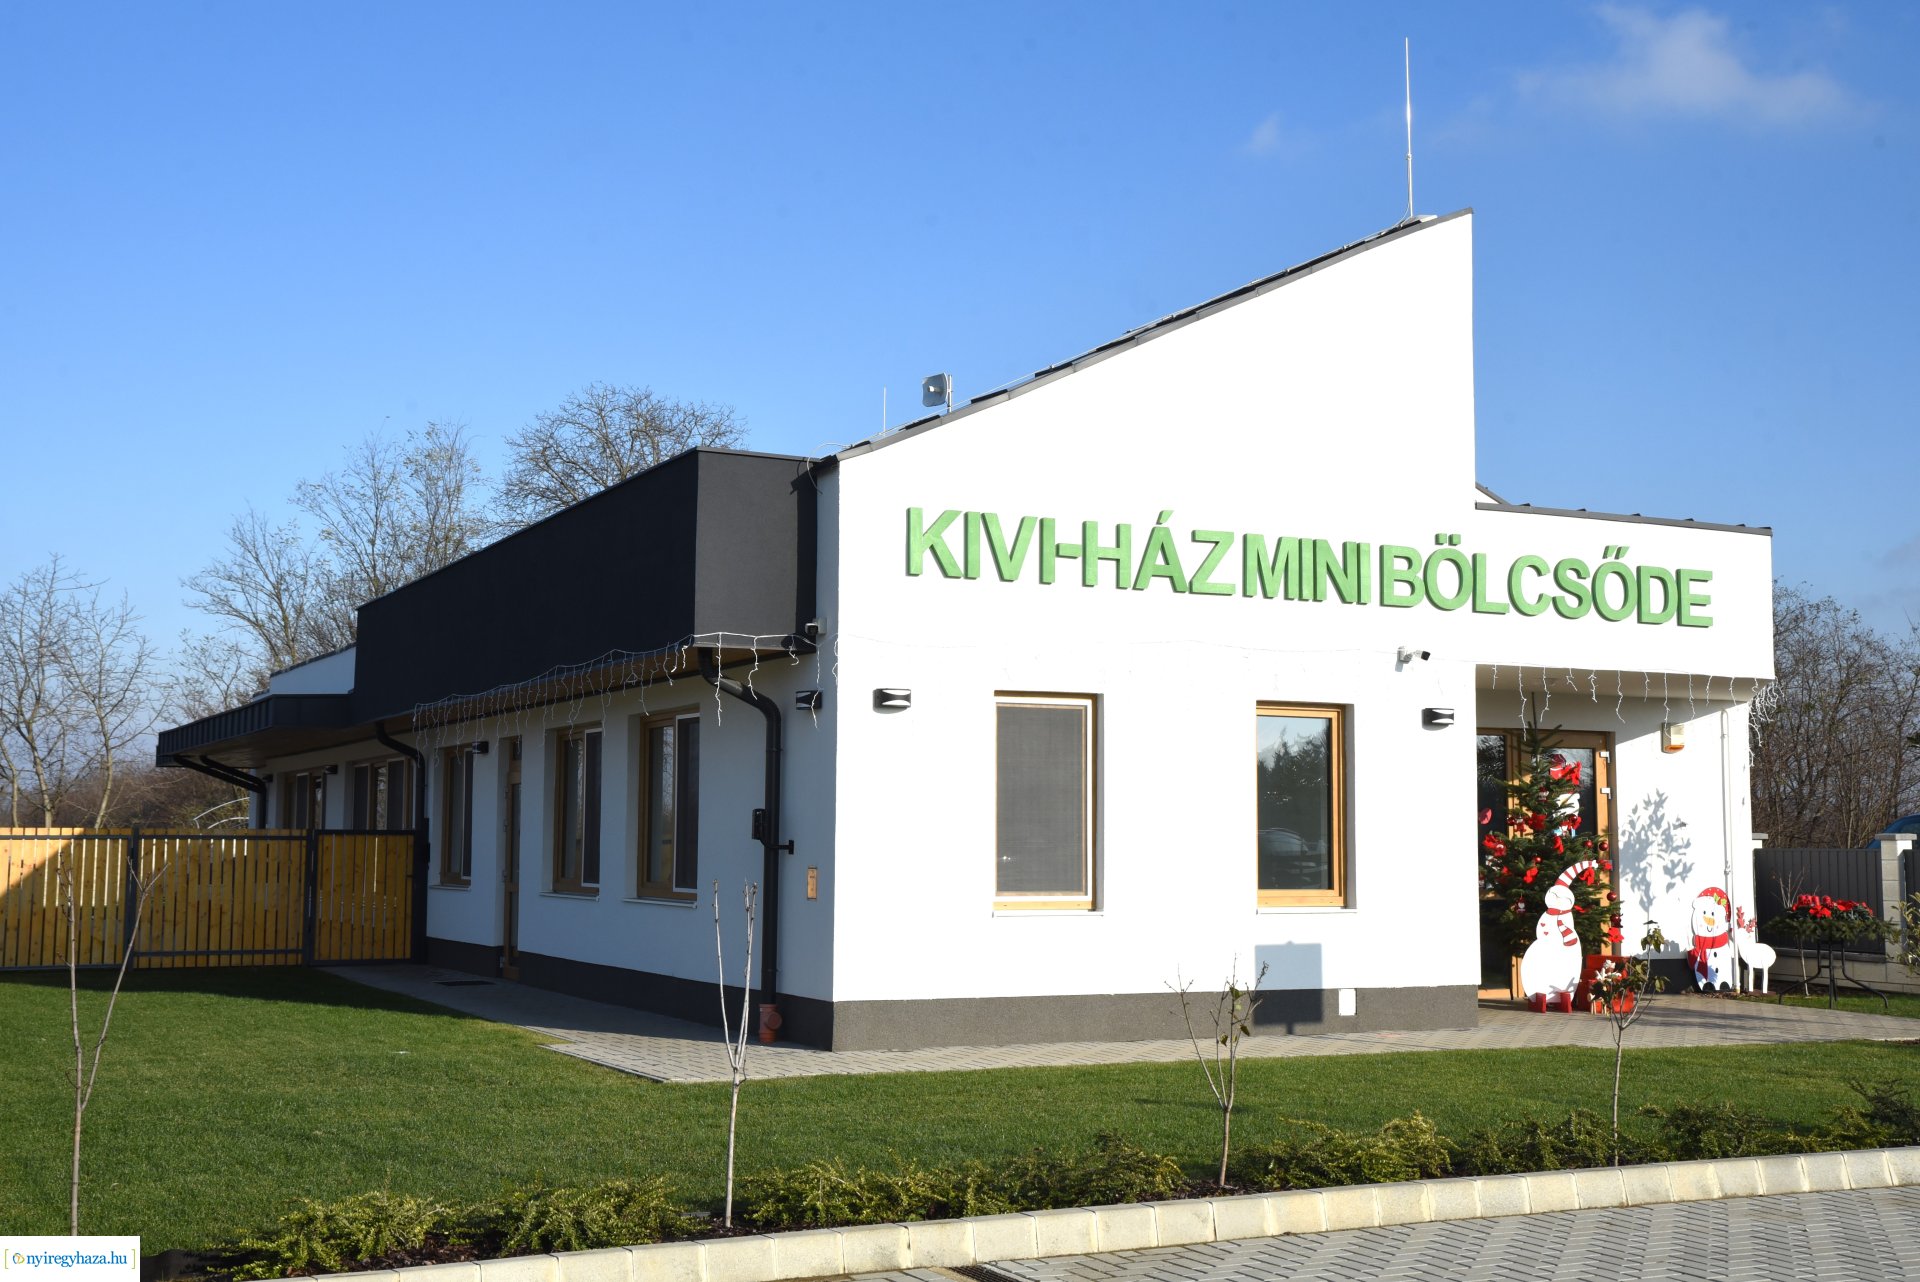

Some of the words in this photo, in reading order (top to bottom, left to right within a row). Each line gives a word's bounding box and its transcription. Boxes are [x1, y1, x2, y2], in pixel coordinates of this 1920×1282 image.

[906, 507, 1236, 595] KIVI-HÁZ
[1242, 533, 1371, 605] MINI
[1379, 533, 1713, 628] BÖLCSŐDE
